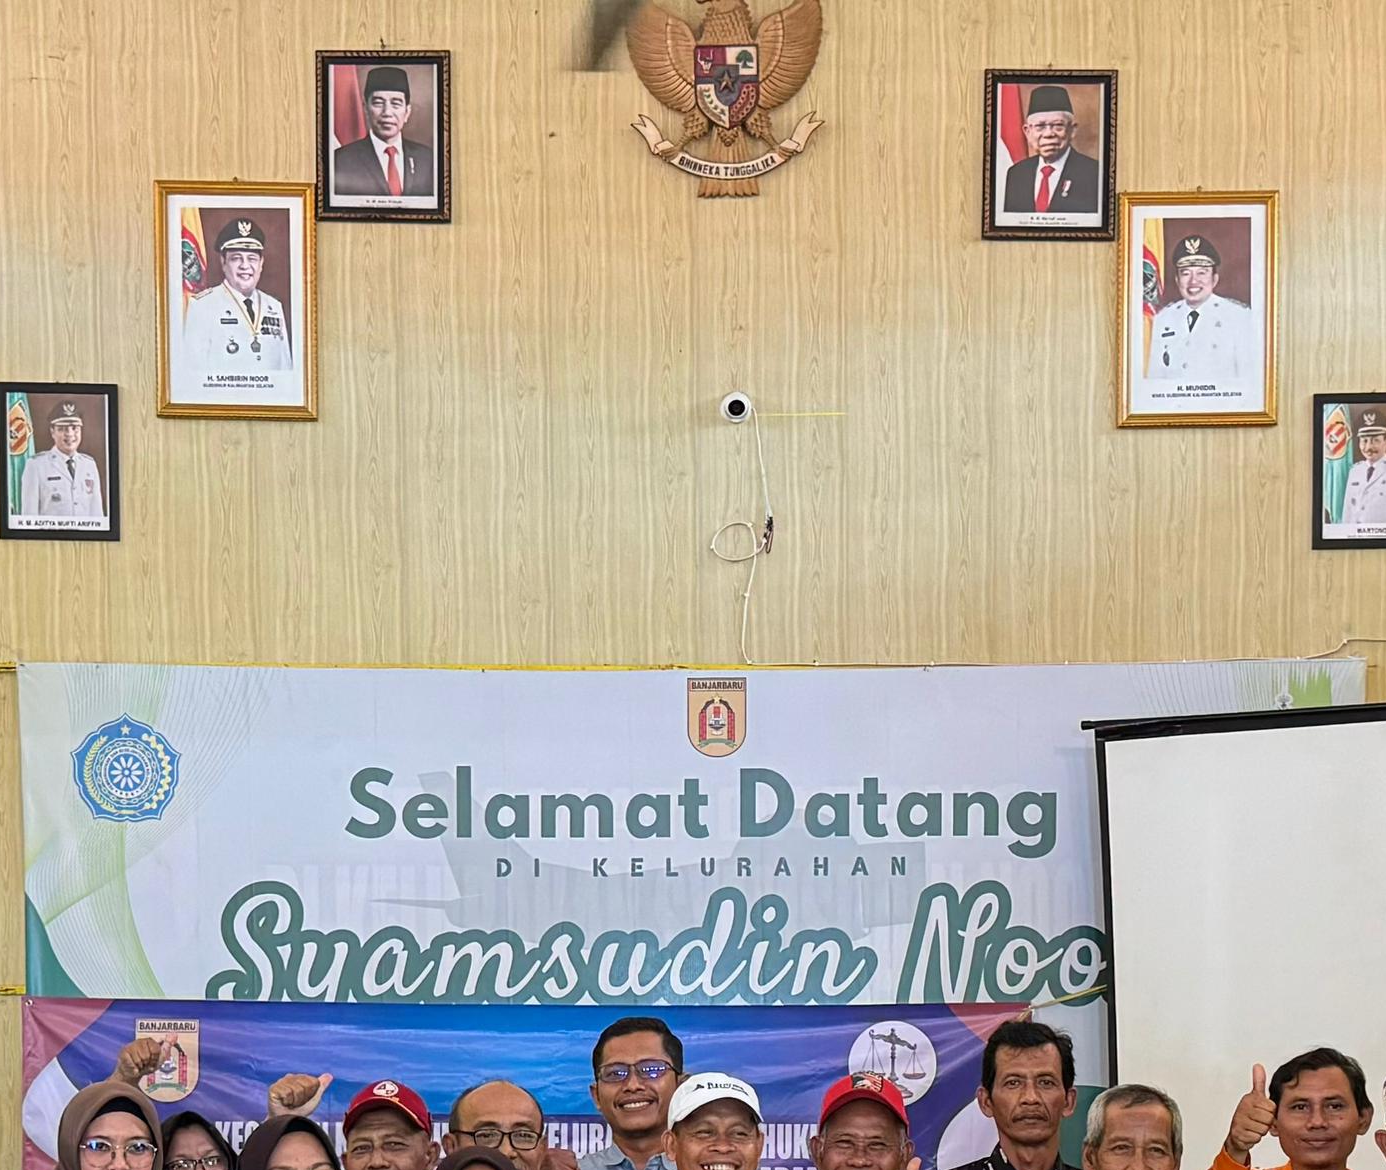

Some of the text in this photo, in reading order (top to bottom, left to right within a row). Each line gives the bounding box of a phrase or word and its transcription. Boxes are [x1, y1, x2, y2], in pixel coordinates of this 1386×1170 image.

[691, 681, 743, 690] BANJARBARU
[344, 765, 1058, 859] Selamat Datang
[496, 856, 907, 878] DI KELURAHAN
[205, 879, 1107, 1007] Syamsudin Noo
[139, 1021, 196, 1031] BANJARBARU
